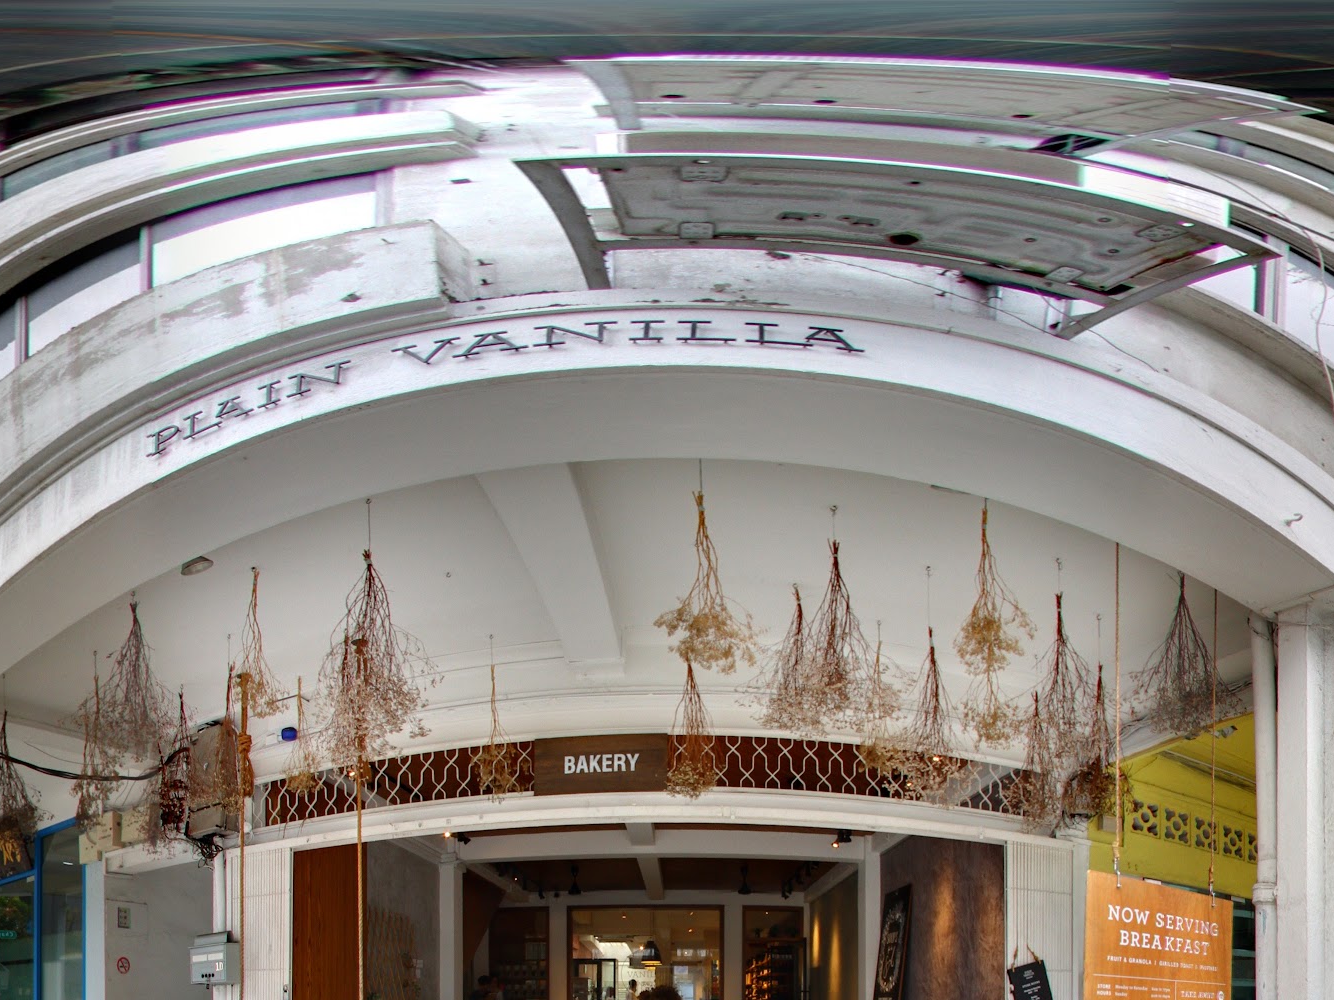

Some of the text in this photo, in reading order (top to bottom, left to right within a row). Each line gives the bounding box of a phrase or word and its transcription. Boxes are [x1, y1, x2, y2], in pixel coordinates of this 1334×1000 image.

[146, 319, 865, 457] PLAIN VANILLA
[564, 753, 640, 774] BAKERY
[1107, 904, 1219, 937] NOW SERVING
[1119, 929, 1210, 956] BREAKFAST
[1128, 957, 1152, 966] GRANOLA
